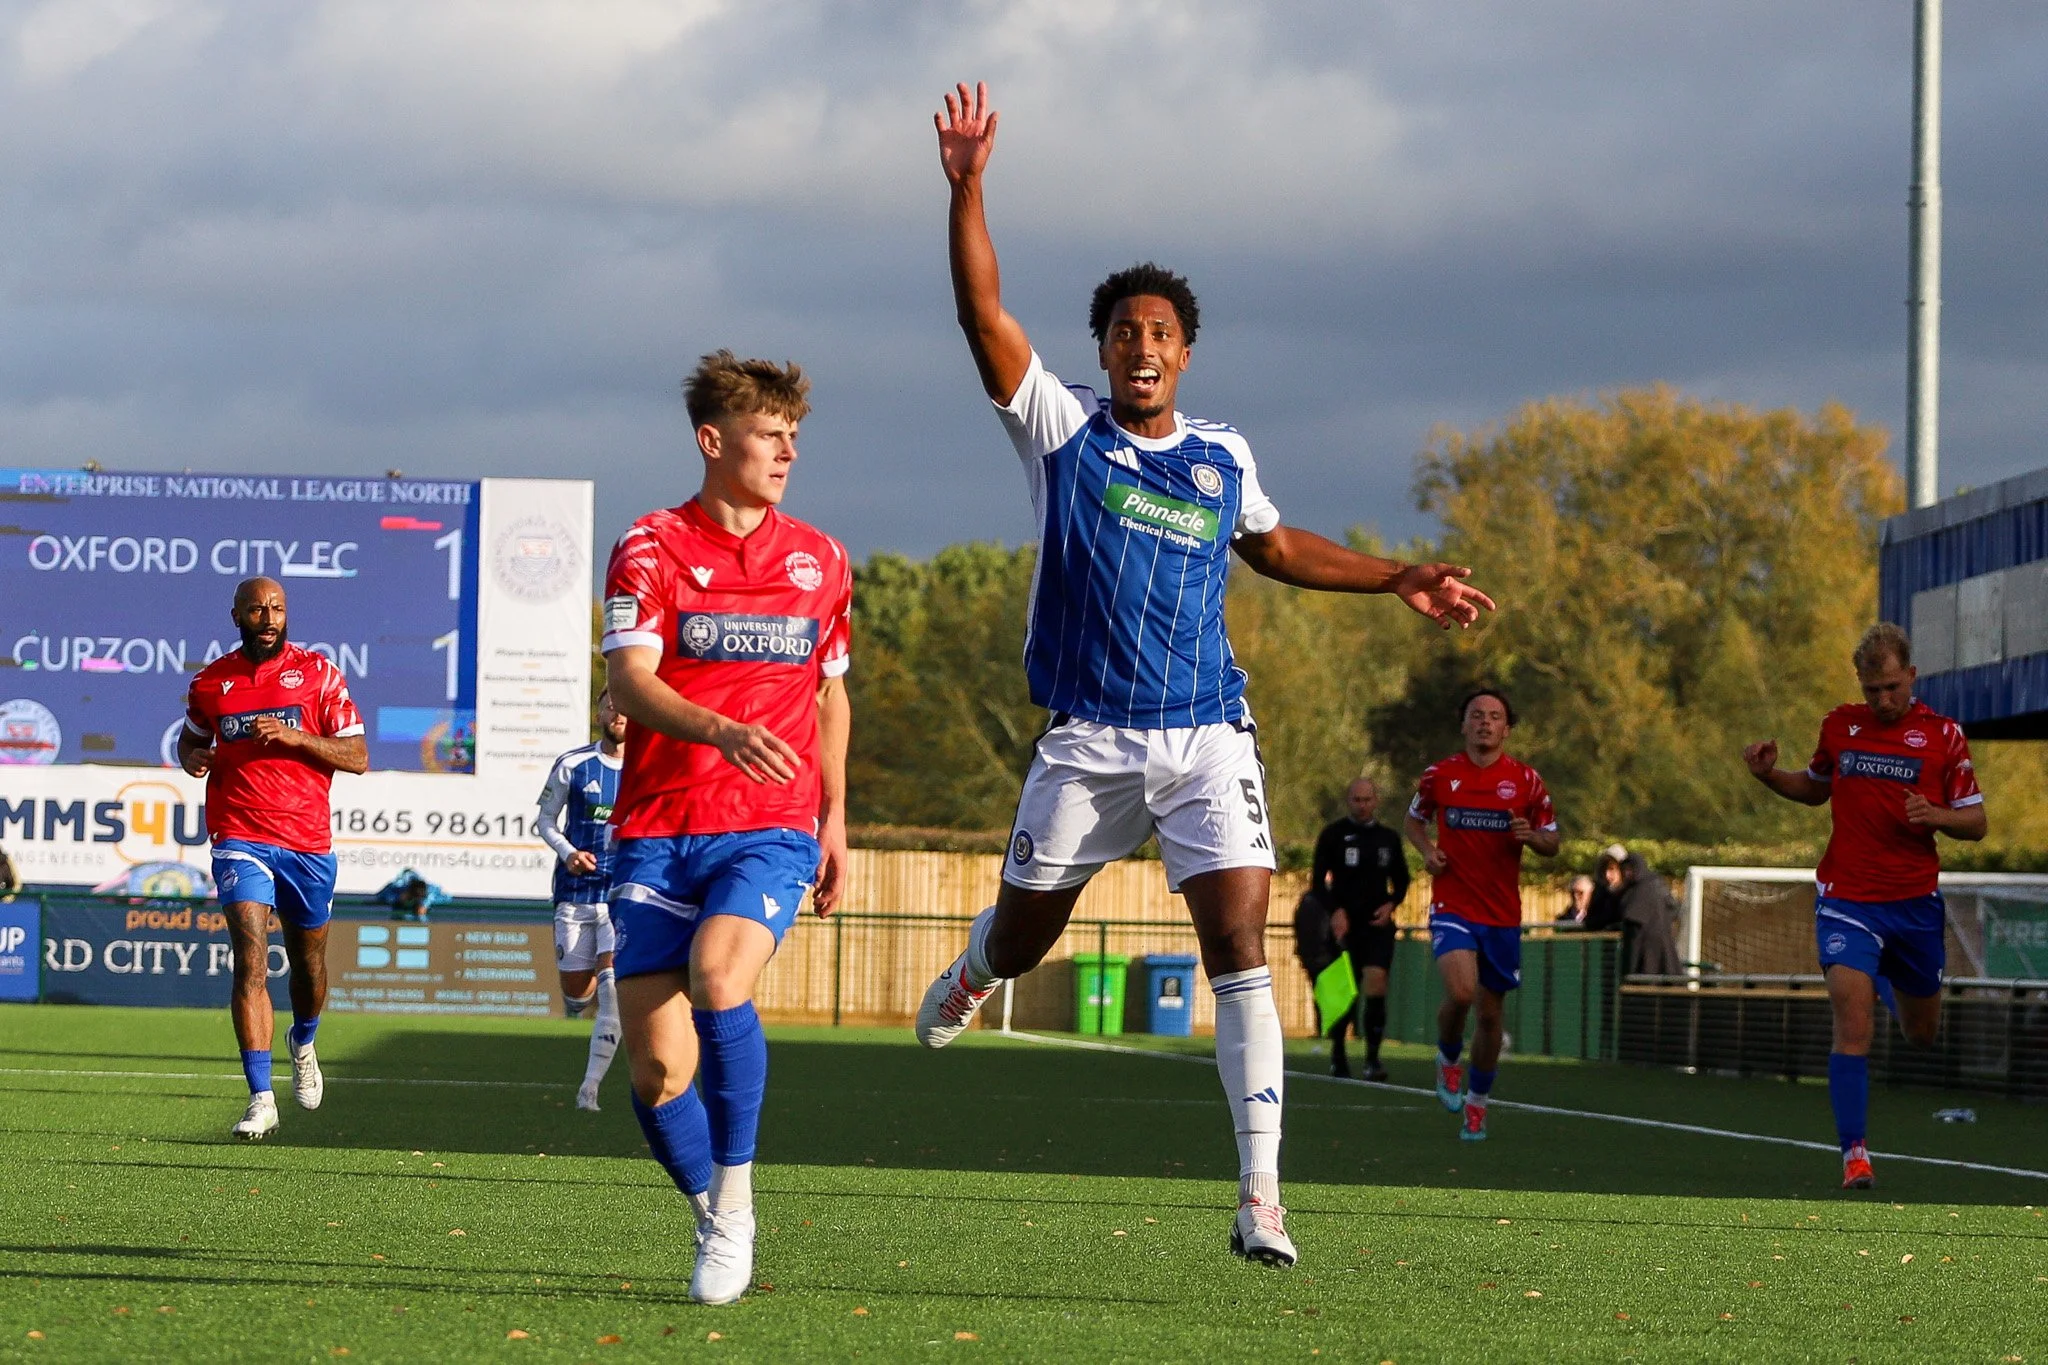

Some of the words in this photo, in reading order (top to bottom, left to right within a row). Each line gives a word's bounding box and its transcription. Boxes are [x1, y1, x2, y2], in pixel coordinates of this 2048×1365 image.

[20, 473, 162, 498] ENTERPRISE
[165, 476, 286, 500] NATIONAL
[290, 479, 387, 503] LEAGUE
[391, 482, 472, 504] NORTH
[1122, 493, 1205, 532] Pinnacle
[1119, 516, 1163, 538] Electrical
[1164, 529, 1201, 549] Supplies
[28, 534, 199, 574] OXFORD
[210, 538, 299, 576] CITY
[434, 527, 463, 601] 1
[724, 621, 782, 633] UNIVERSITY
[785, 623, 800, 633] OF
[722, 634, 813, 657] OXFORD
[12, 635, 187, 675] CURZON
[431, 629, 460, 701] 1
[1856, 761, 1914, 779] OXFORD
[1238, 778, 1263, 825] 5
[1461, 817, 1507, 828] OXFORD
[126, 907, 192, 932] proud
[103, 939, 199, 976] CITY
